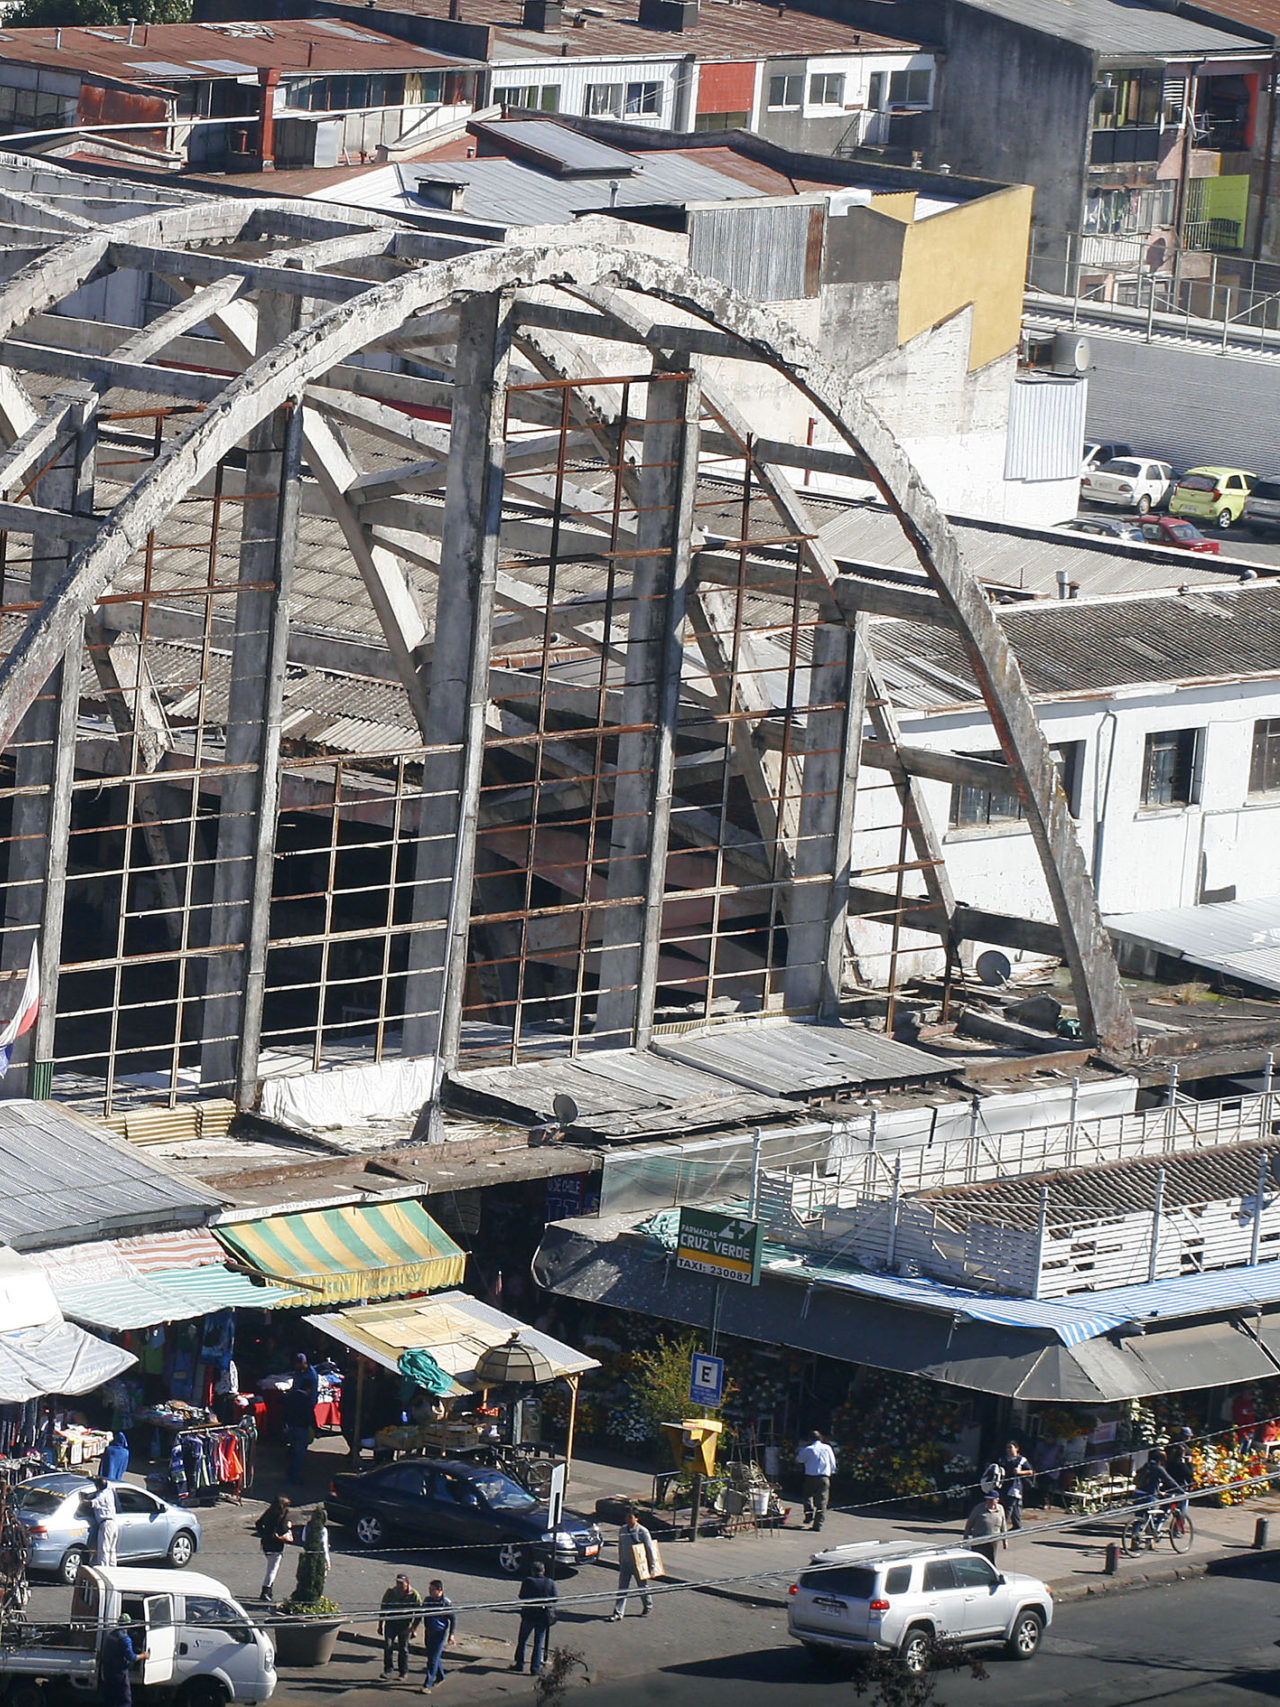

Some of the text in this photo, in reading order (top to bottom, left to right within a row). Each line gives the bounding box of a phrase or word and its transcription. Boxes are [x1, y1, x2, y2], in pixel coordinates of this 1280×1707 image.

[681, 1224, 717, 1239] FARMACIAS
[680, 1233, 750, 1260] CRUZ VERDE
[679, 1258, 750, 1281] TAXI: 230087
[702, 1365, 712, 1383] E
